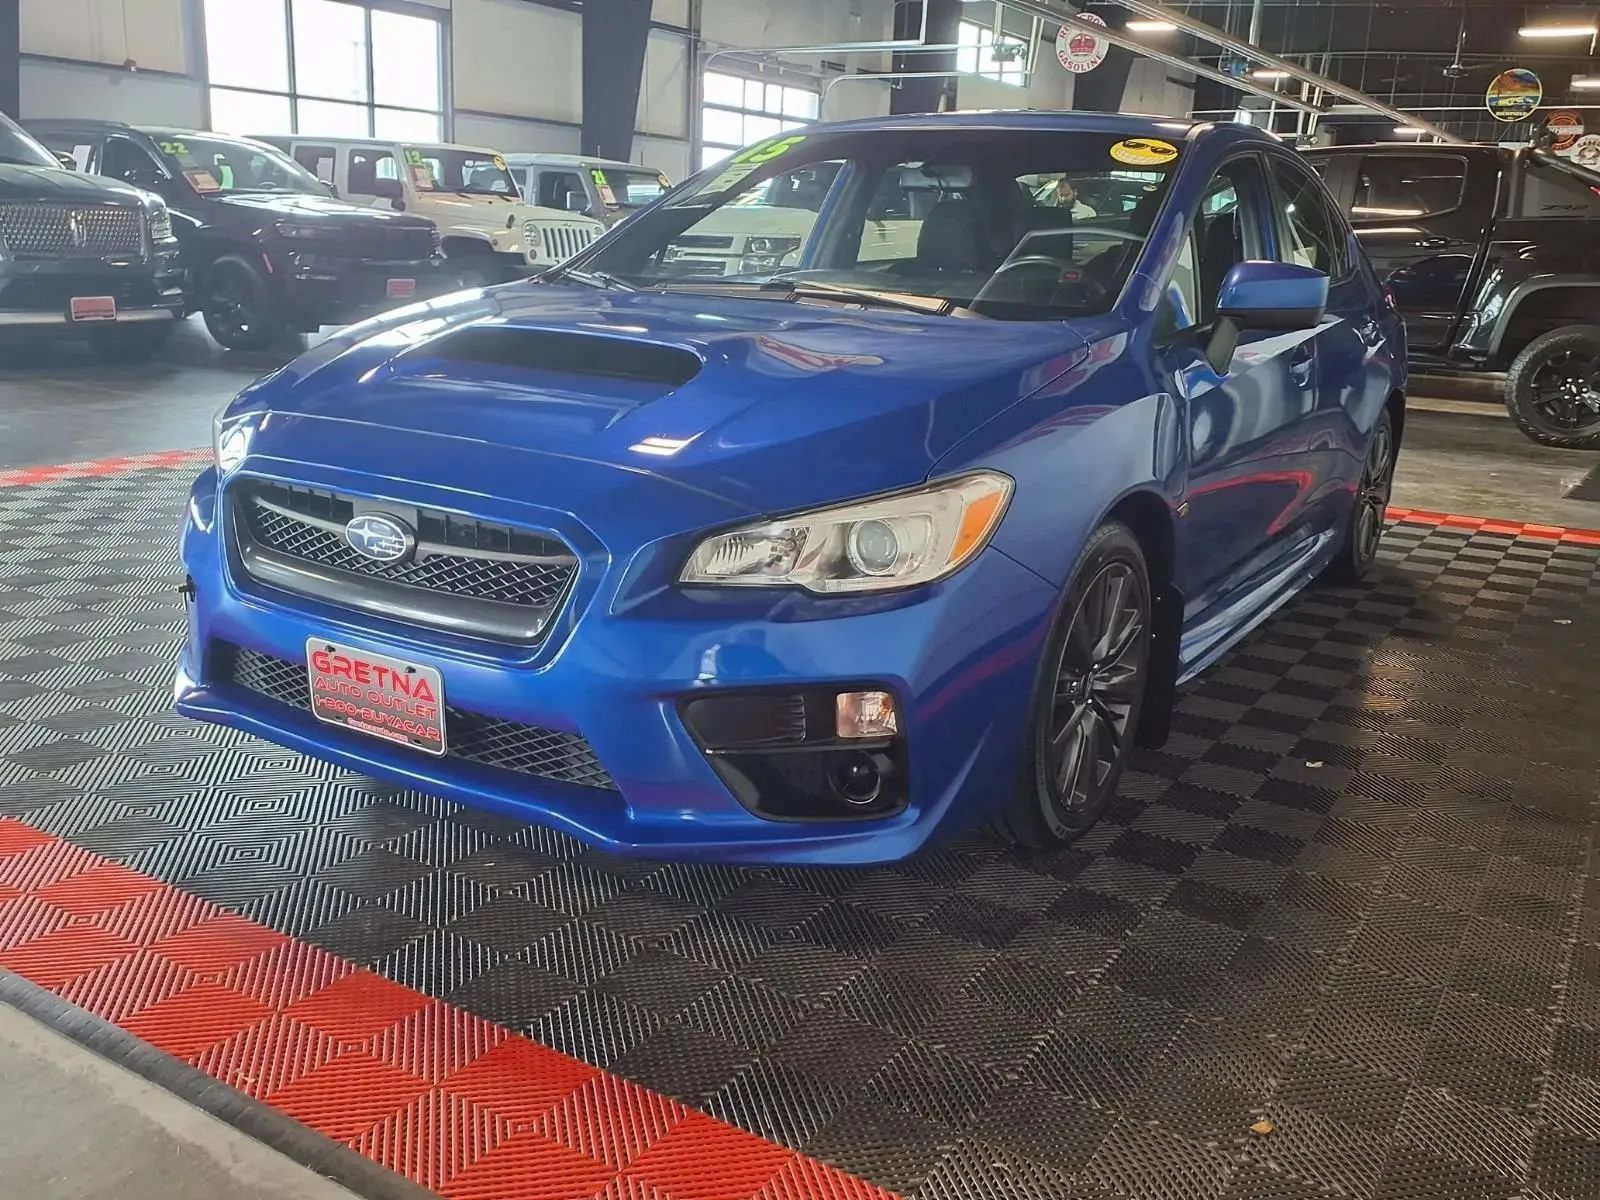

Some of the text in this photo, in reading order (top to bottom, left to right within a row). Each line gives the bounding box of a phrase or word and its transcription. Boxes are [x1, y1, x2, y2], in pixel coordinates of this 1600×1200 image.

[1058, 50, 1104, 71] GASOLINE
[160, 142, 189, 154] 22
[728, 136, 807, 163] 15
[312, 650, 435, 702] GRETNA
[314, 676, 439, 721] AUTO OUTLET
[314, 694, 440, 742] 1-800-BUYACAR
